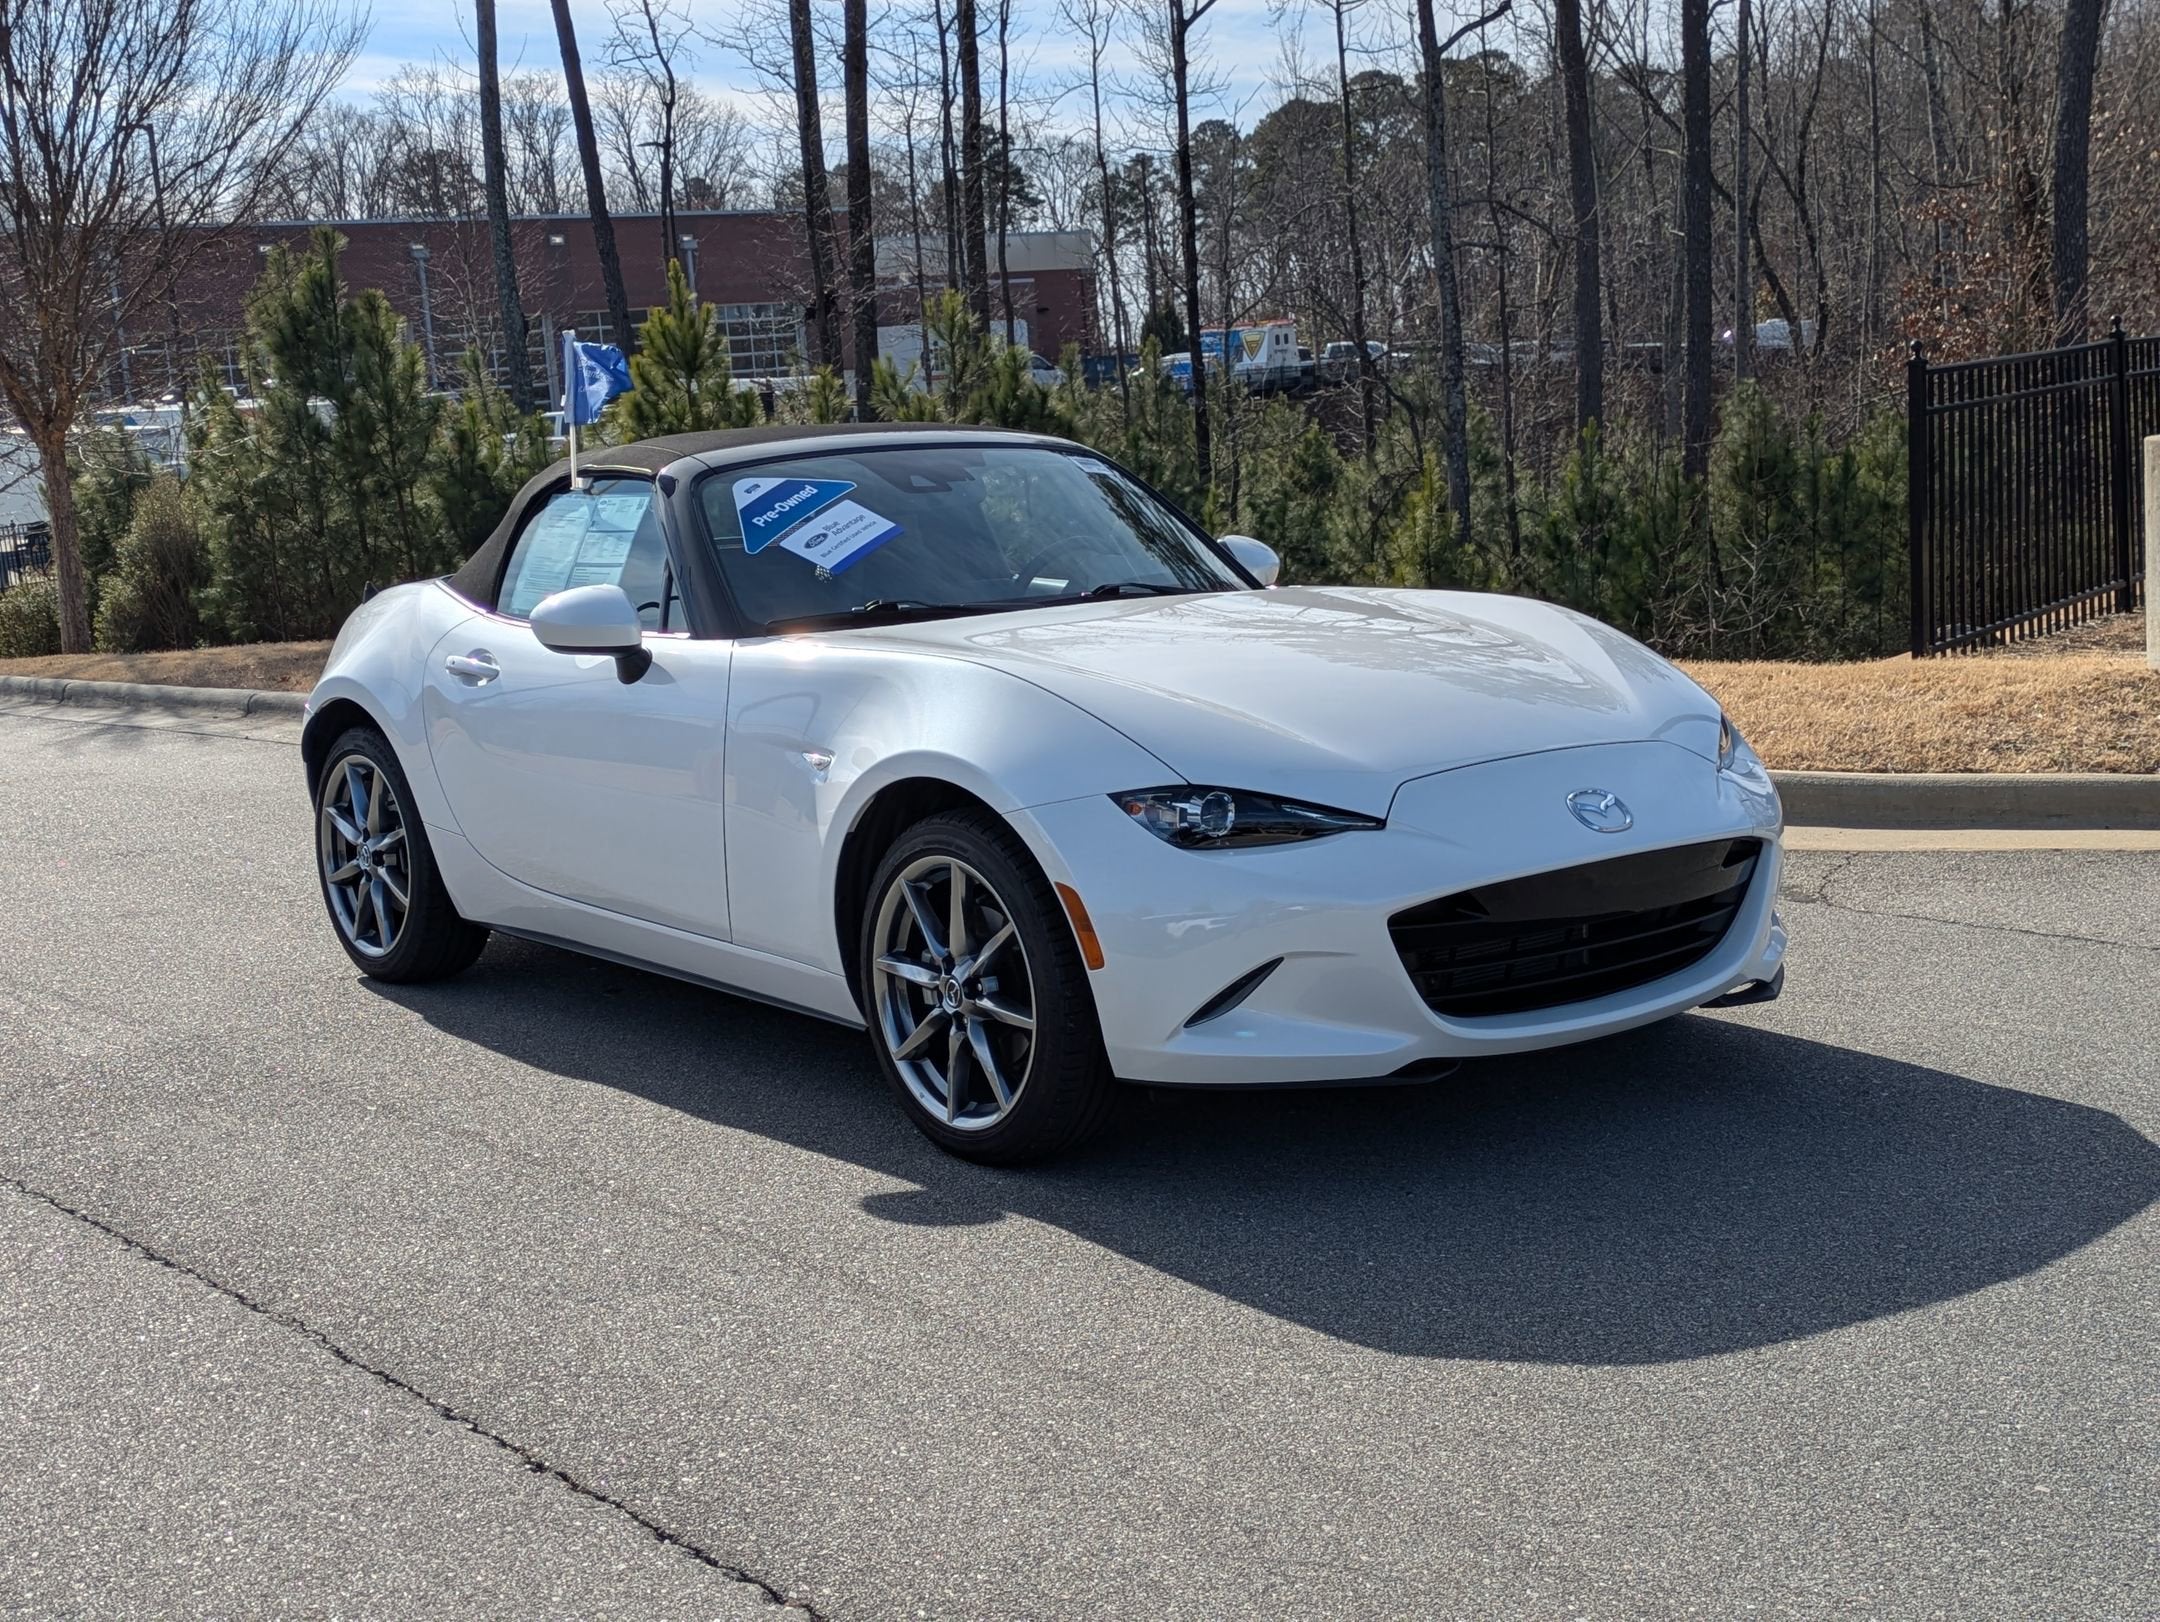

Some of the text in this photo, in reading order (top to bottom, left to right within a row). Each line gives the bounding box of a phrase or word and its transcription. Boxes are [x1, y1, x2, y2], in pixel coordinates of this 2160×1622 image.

[752, 484, 819, 527] Pre-Owned
[823, 520, 841, 532] Blue
[831, 514, 867, 536] Advantage
[806, 534, 827, 548] Ford
[820, 548, 833, 558] Blue
[831, 536, 852, 552] Certified
[849, 529, 864, 540] Used
